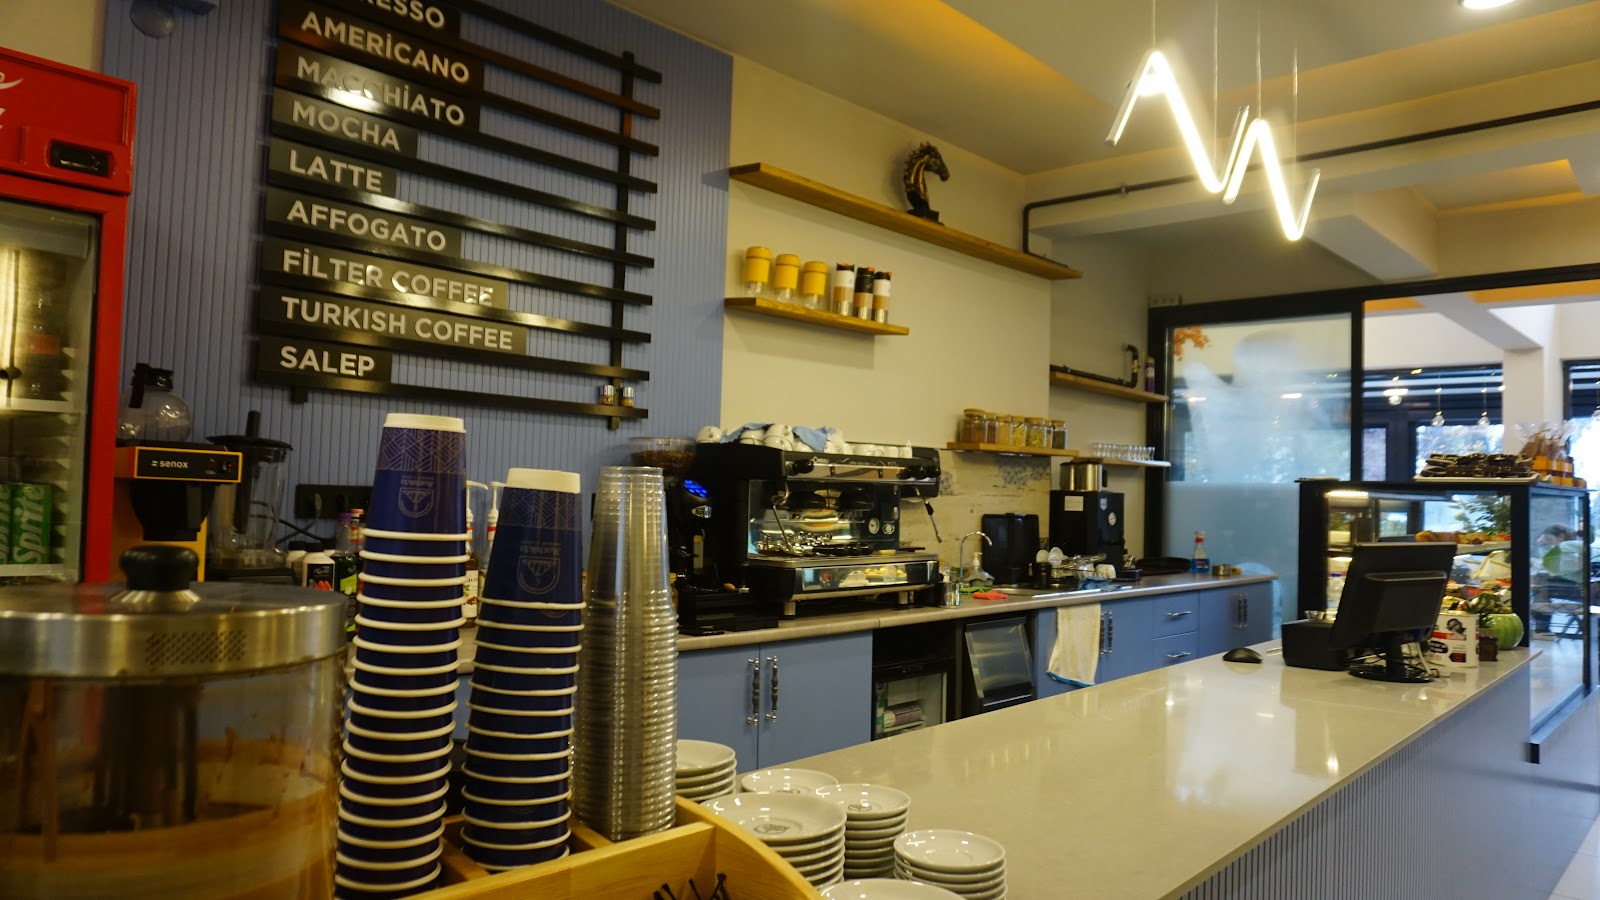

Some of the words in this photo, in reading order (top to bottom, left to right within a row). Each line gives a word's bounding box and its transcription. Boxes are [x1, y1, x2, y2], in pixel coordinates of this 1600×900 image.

[292, 100, 400, 151] MOCHA
[289, 149, 383, 193] LATTE
[286, 200, 447, 251] AFFOGATO
[391, 271, 494, 306] COFFEE
[281, 296, 405, 335] TURKISH
[414, 318, 513, 350] COFFEE
[279, 346, 375, 377] SALEP
[159, 460, 189, 469] senox
[13, 485, 46, 564] Sprite
